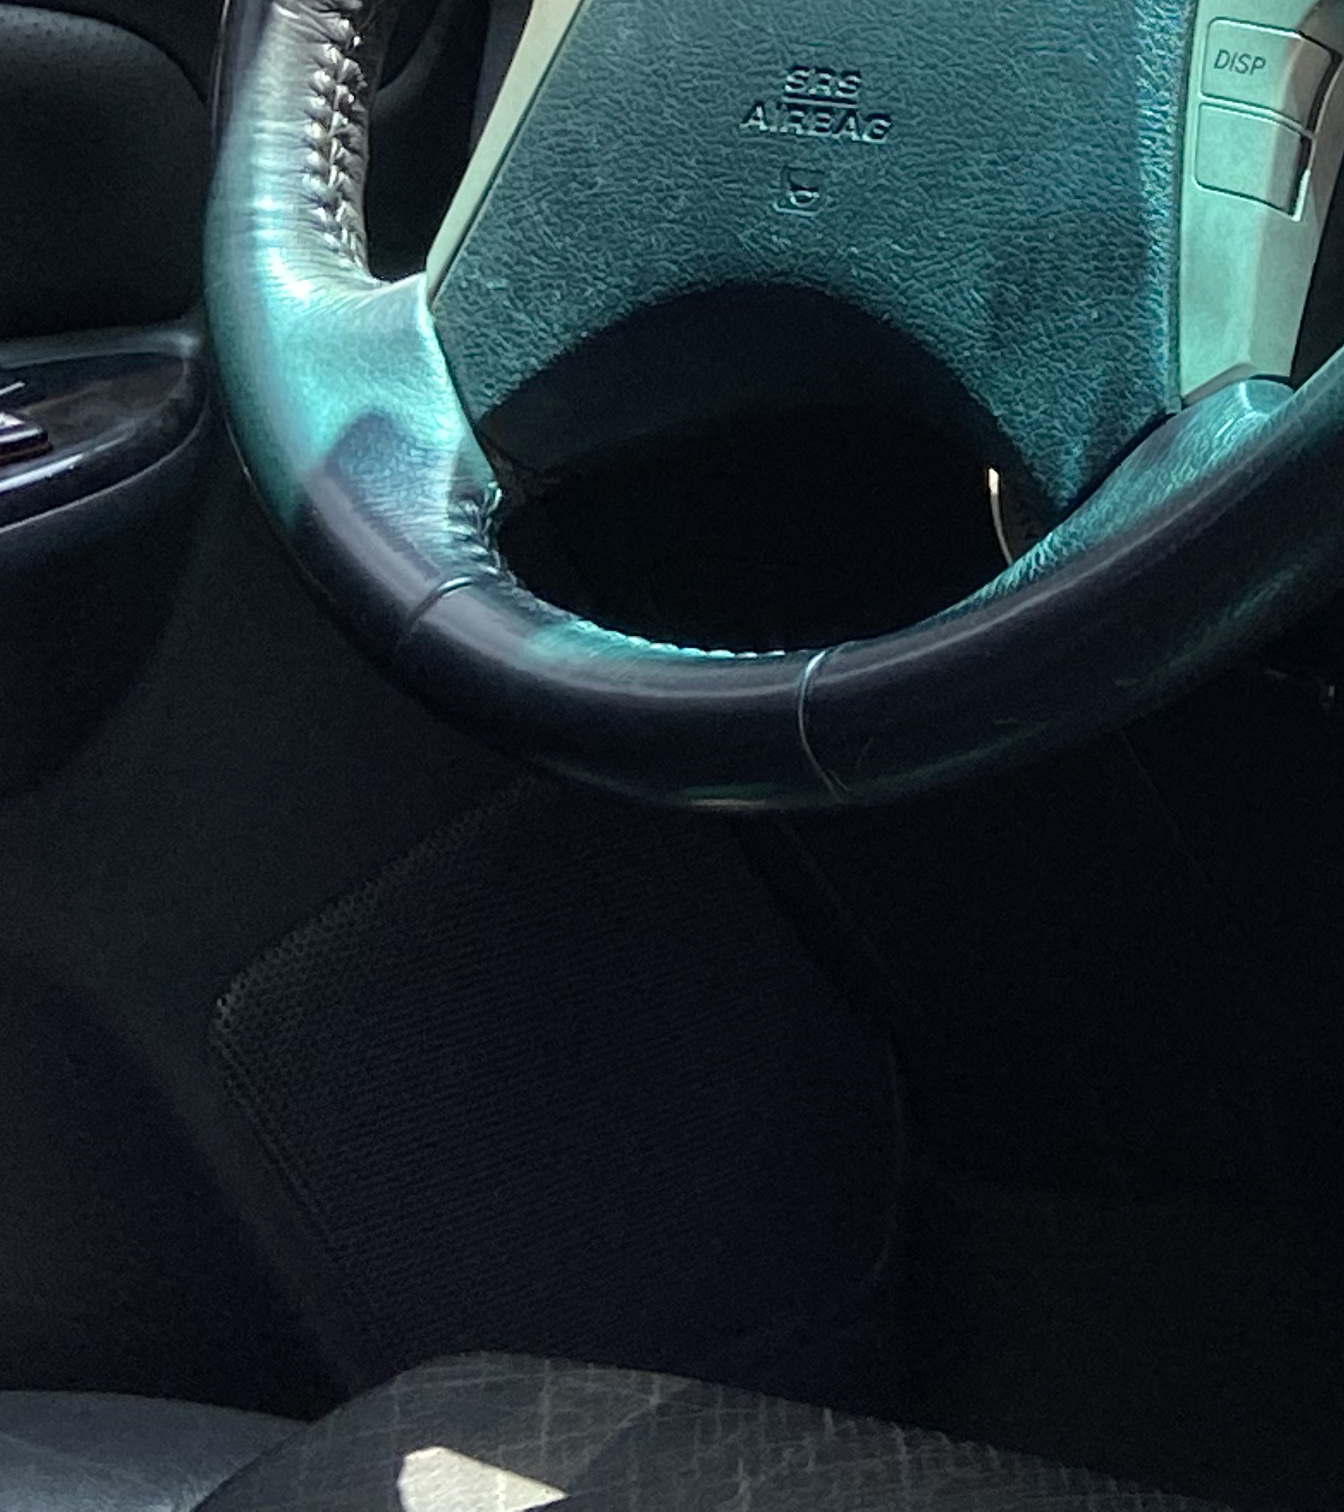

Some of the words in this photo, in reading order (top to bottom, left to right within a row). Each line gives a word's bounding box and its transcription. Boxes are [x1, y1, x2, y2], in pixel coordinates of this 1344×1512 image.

[1213, 49, 1267, 76] DISP
[785, 66, 861, 97] SRS
[738, 102, 893, 144] AIRBAG
